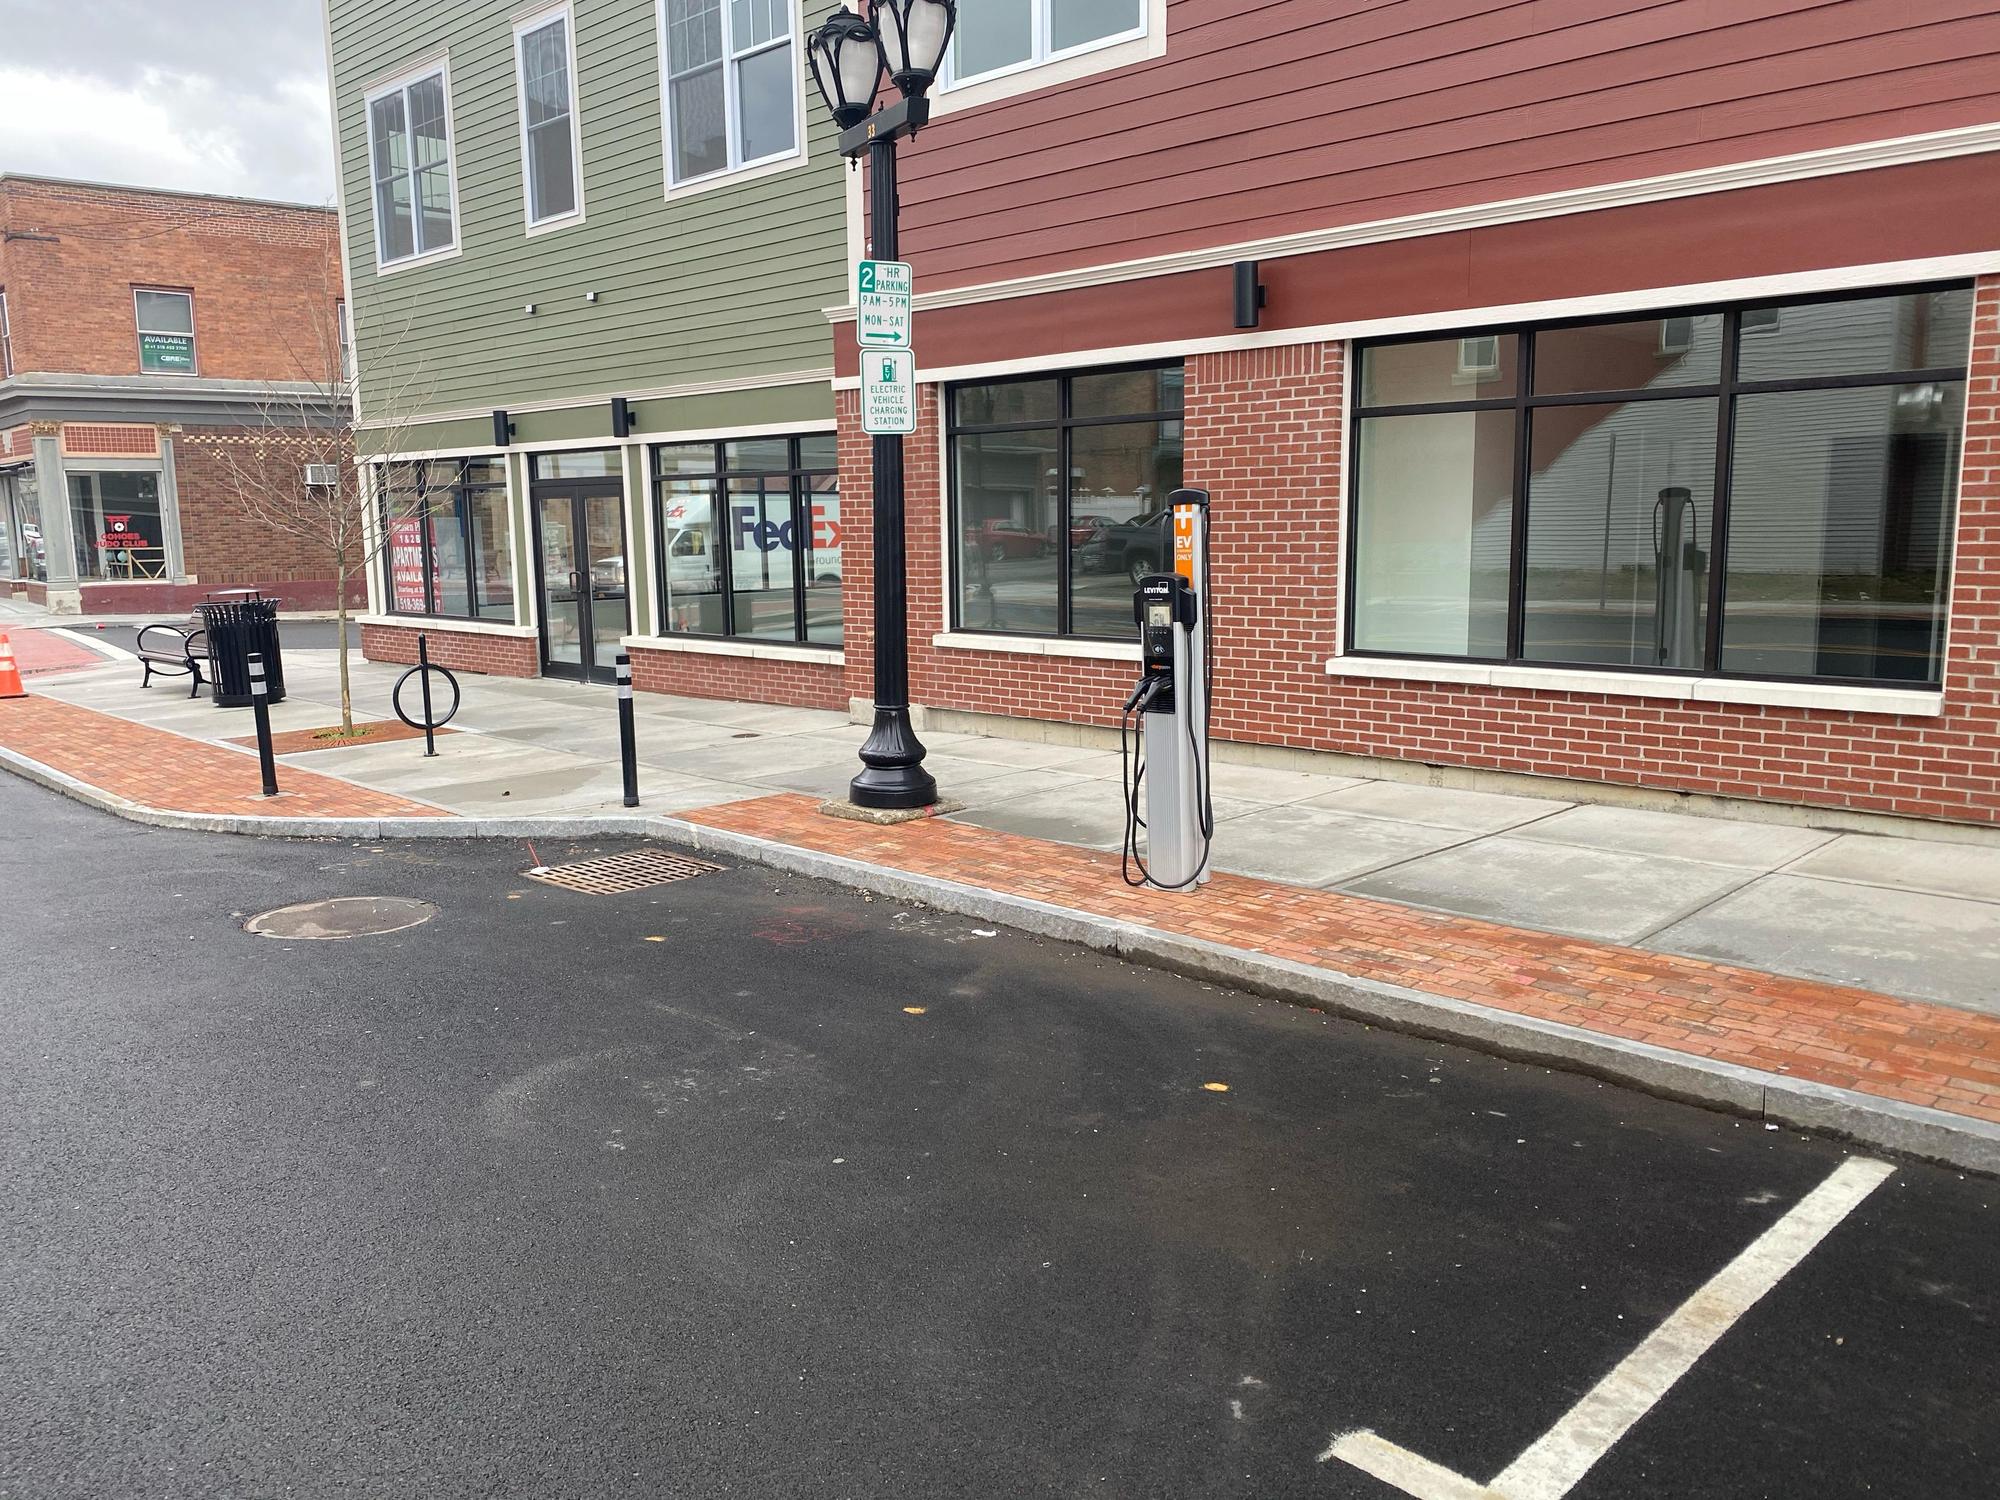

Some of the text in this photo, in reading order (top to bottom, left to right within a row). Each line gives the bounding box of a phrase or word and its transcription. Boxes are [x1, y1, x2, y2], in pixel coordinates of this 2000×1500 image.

[886, 268, 900, 278] HR
[876, 280, 908, 292] PARKING
[864, 314, 904, 327] MON-SAT
[144, 336, 187, 344] AVAILABLE
[870, 385, 906, 394] ELECTRIC
[872, 395, 905, 404] VEHICLE
[869, 406, 908, 415] CHARGING
[873, 416, 905, 425] STATION
[410, 534, 415, 543] 2
[1176, 535, 1192, 548] EV
[94, 540, 120, 548] JUDO
[1143, 586, 1170, 594] LEVITON
